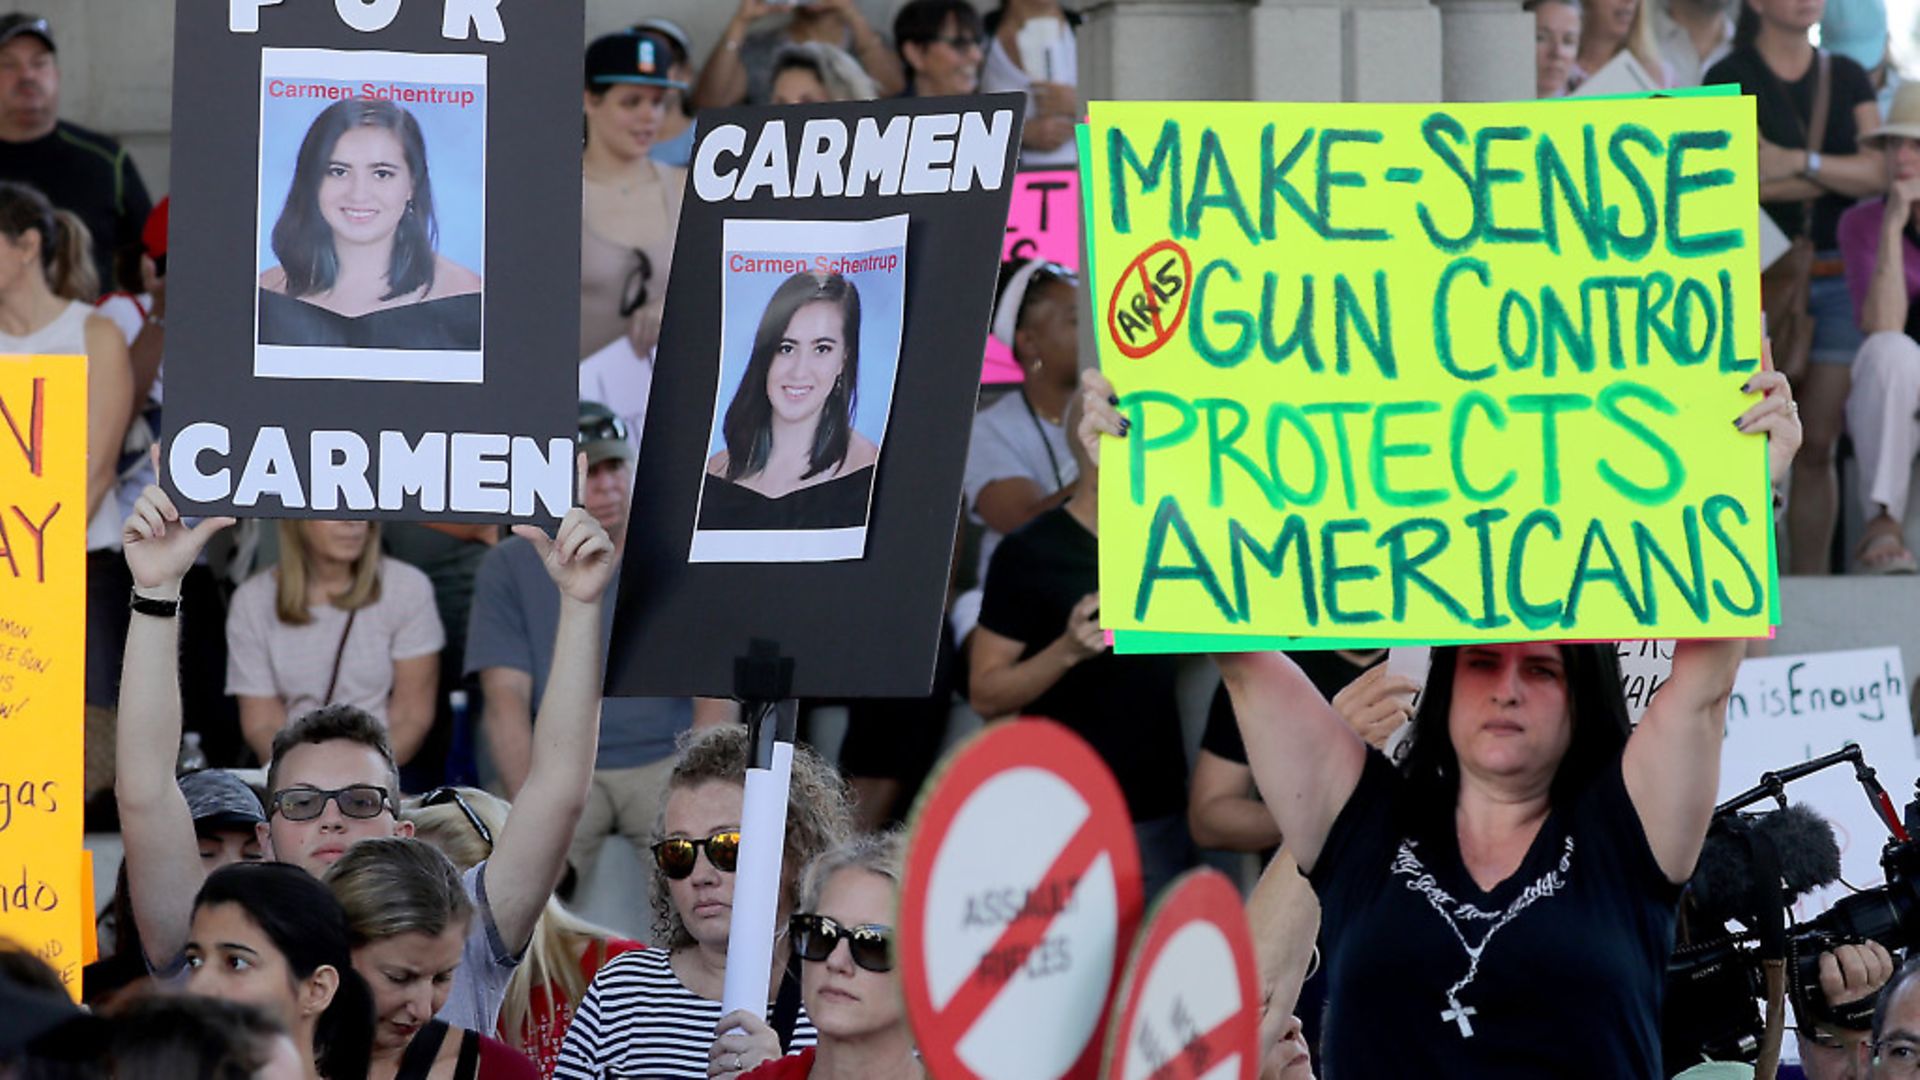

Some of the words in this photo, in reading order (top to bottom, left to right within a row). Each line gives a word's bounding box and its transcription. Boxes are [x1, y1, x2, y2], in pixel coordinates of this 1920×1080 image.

[268, 79, 354, 100] Carmen
[361, 83, 475, 108] Schentrup
[693, 109, 1014, 202] CARMEN
[1106, 111, 1745, 260] MAKE-SENSE
[729, 254, 807, 273] Carmen
[814, 251, 898, 276] Schentrup
[1188, 258, 1398, 379] GUN
[1432, 256, 1759, 382] CONTROL
[168, 422, 574, 518] CARMEN
[1126, 380, 1687, 510] PROTECTS
[1133, 493, 1763, 629] AMERICANS
[1788, 661, 1901, 721] Enough
